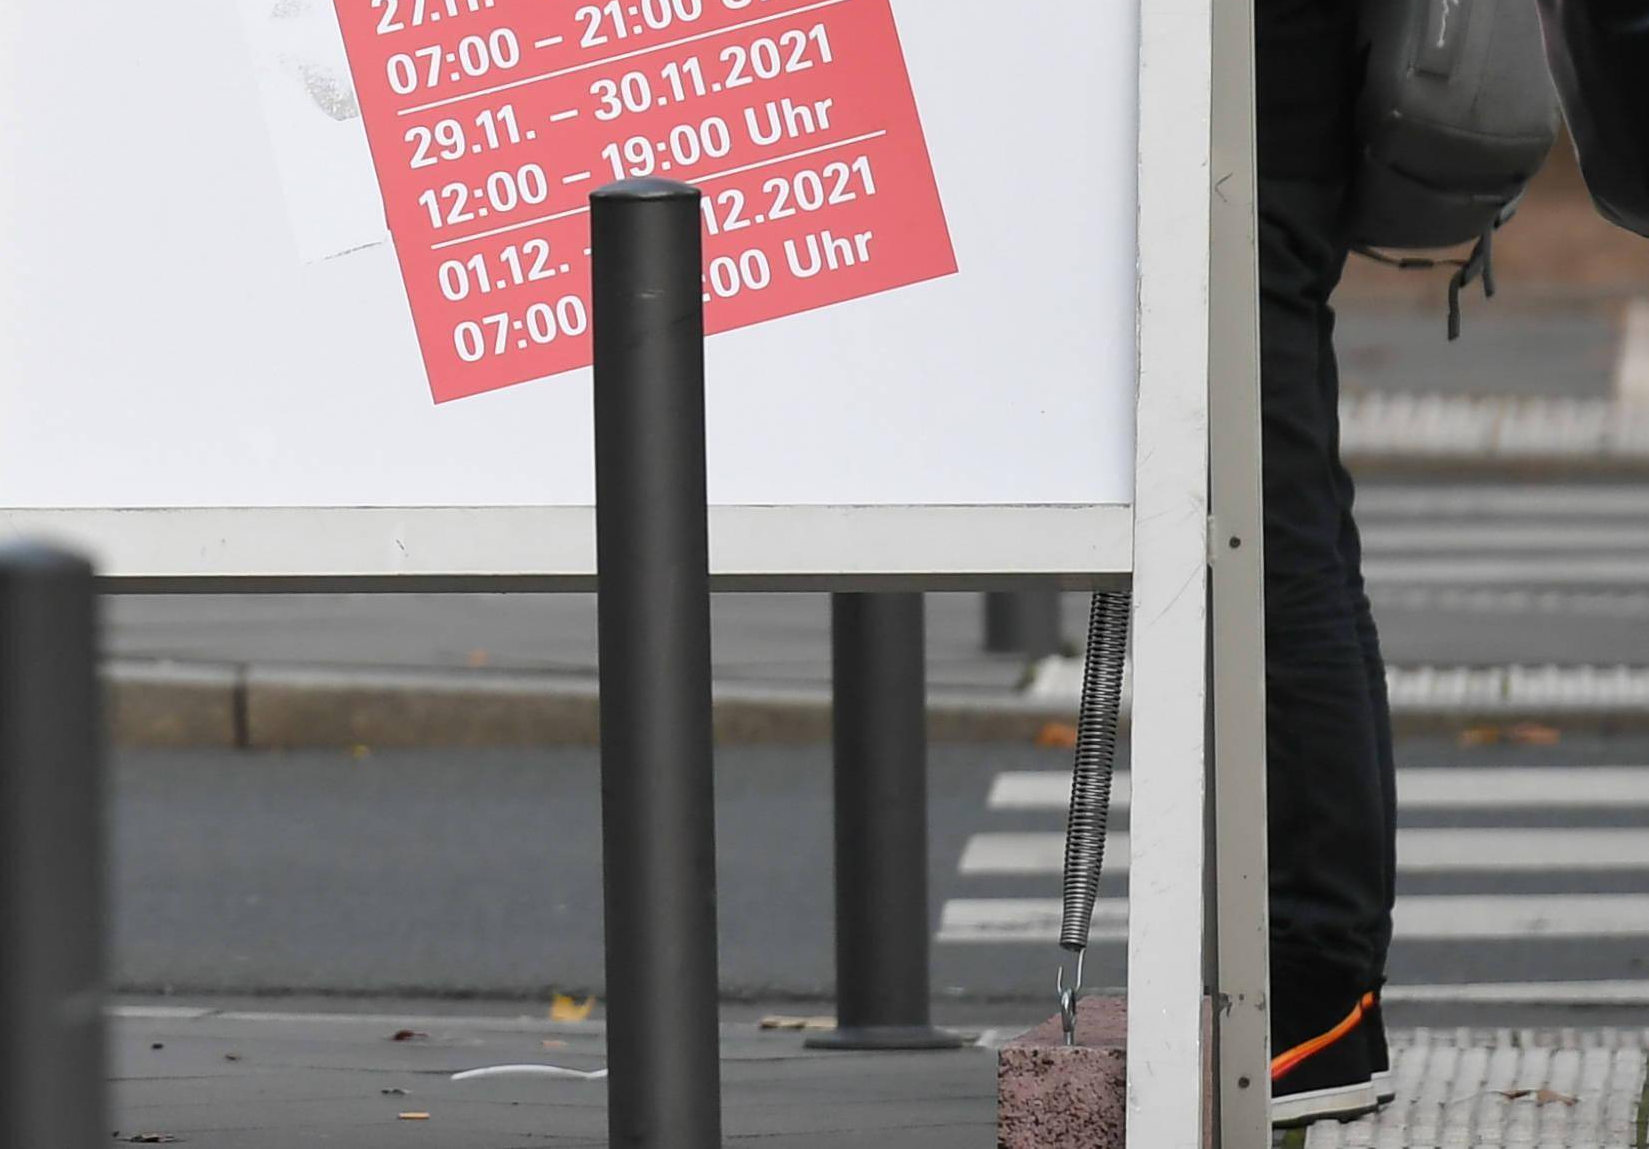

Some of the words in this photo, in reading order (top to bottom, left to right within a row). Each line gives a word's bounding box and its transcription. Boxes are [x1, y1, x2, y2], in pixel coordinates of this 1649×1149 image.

[386, 27, 520, 95] 07:00
[404, 104, 537, 169] 29.11.
[589, 23, 833, 121] 30.11.2021
[418, 163, 548, 229] 12:00
[601, 116, 732, 182] 19:00
[743, 98, 833, 146] Uhr
[438, 238, 570, 302] 01.12.
[453, 295, 587, 362] 07:00
[783, 230, 873, 278] Uhr
